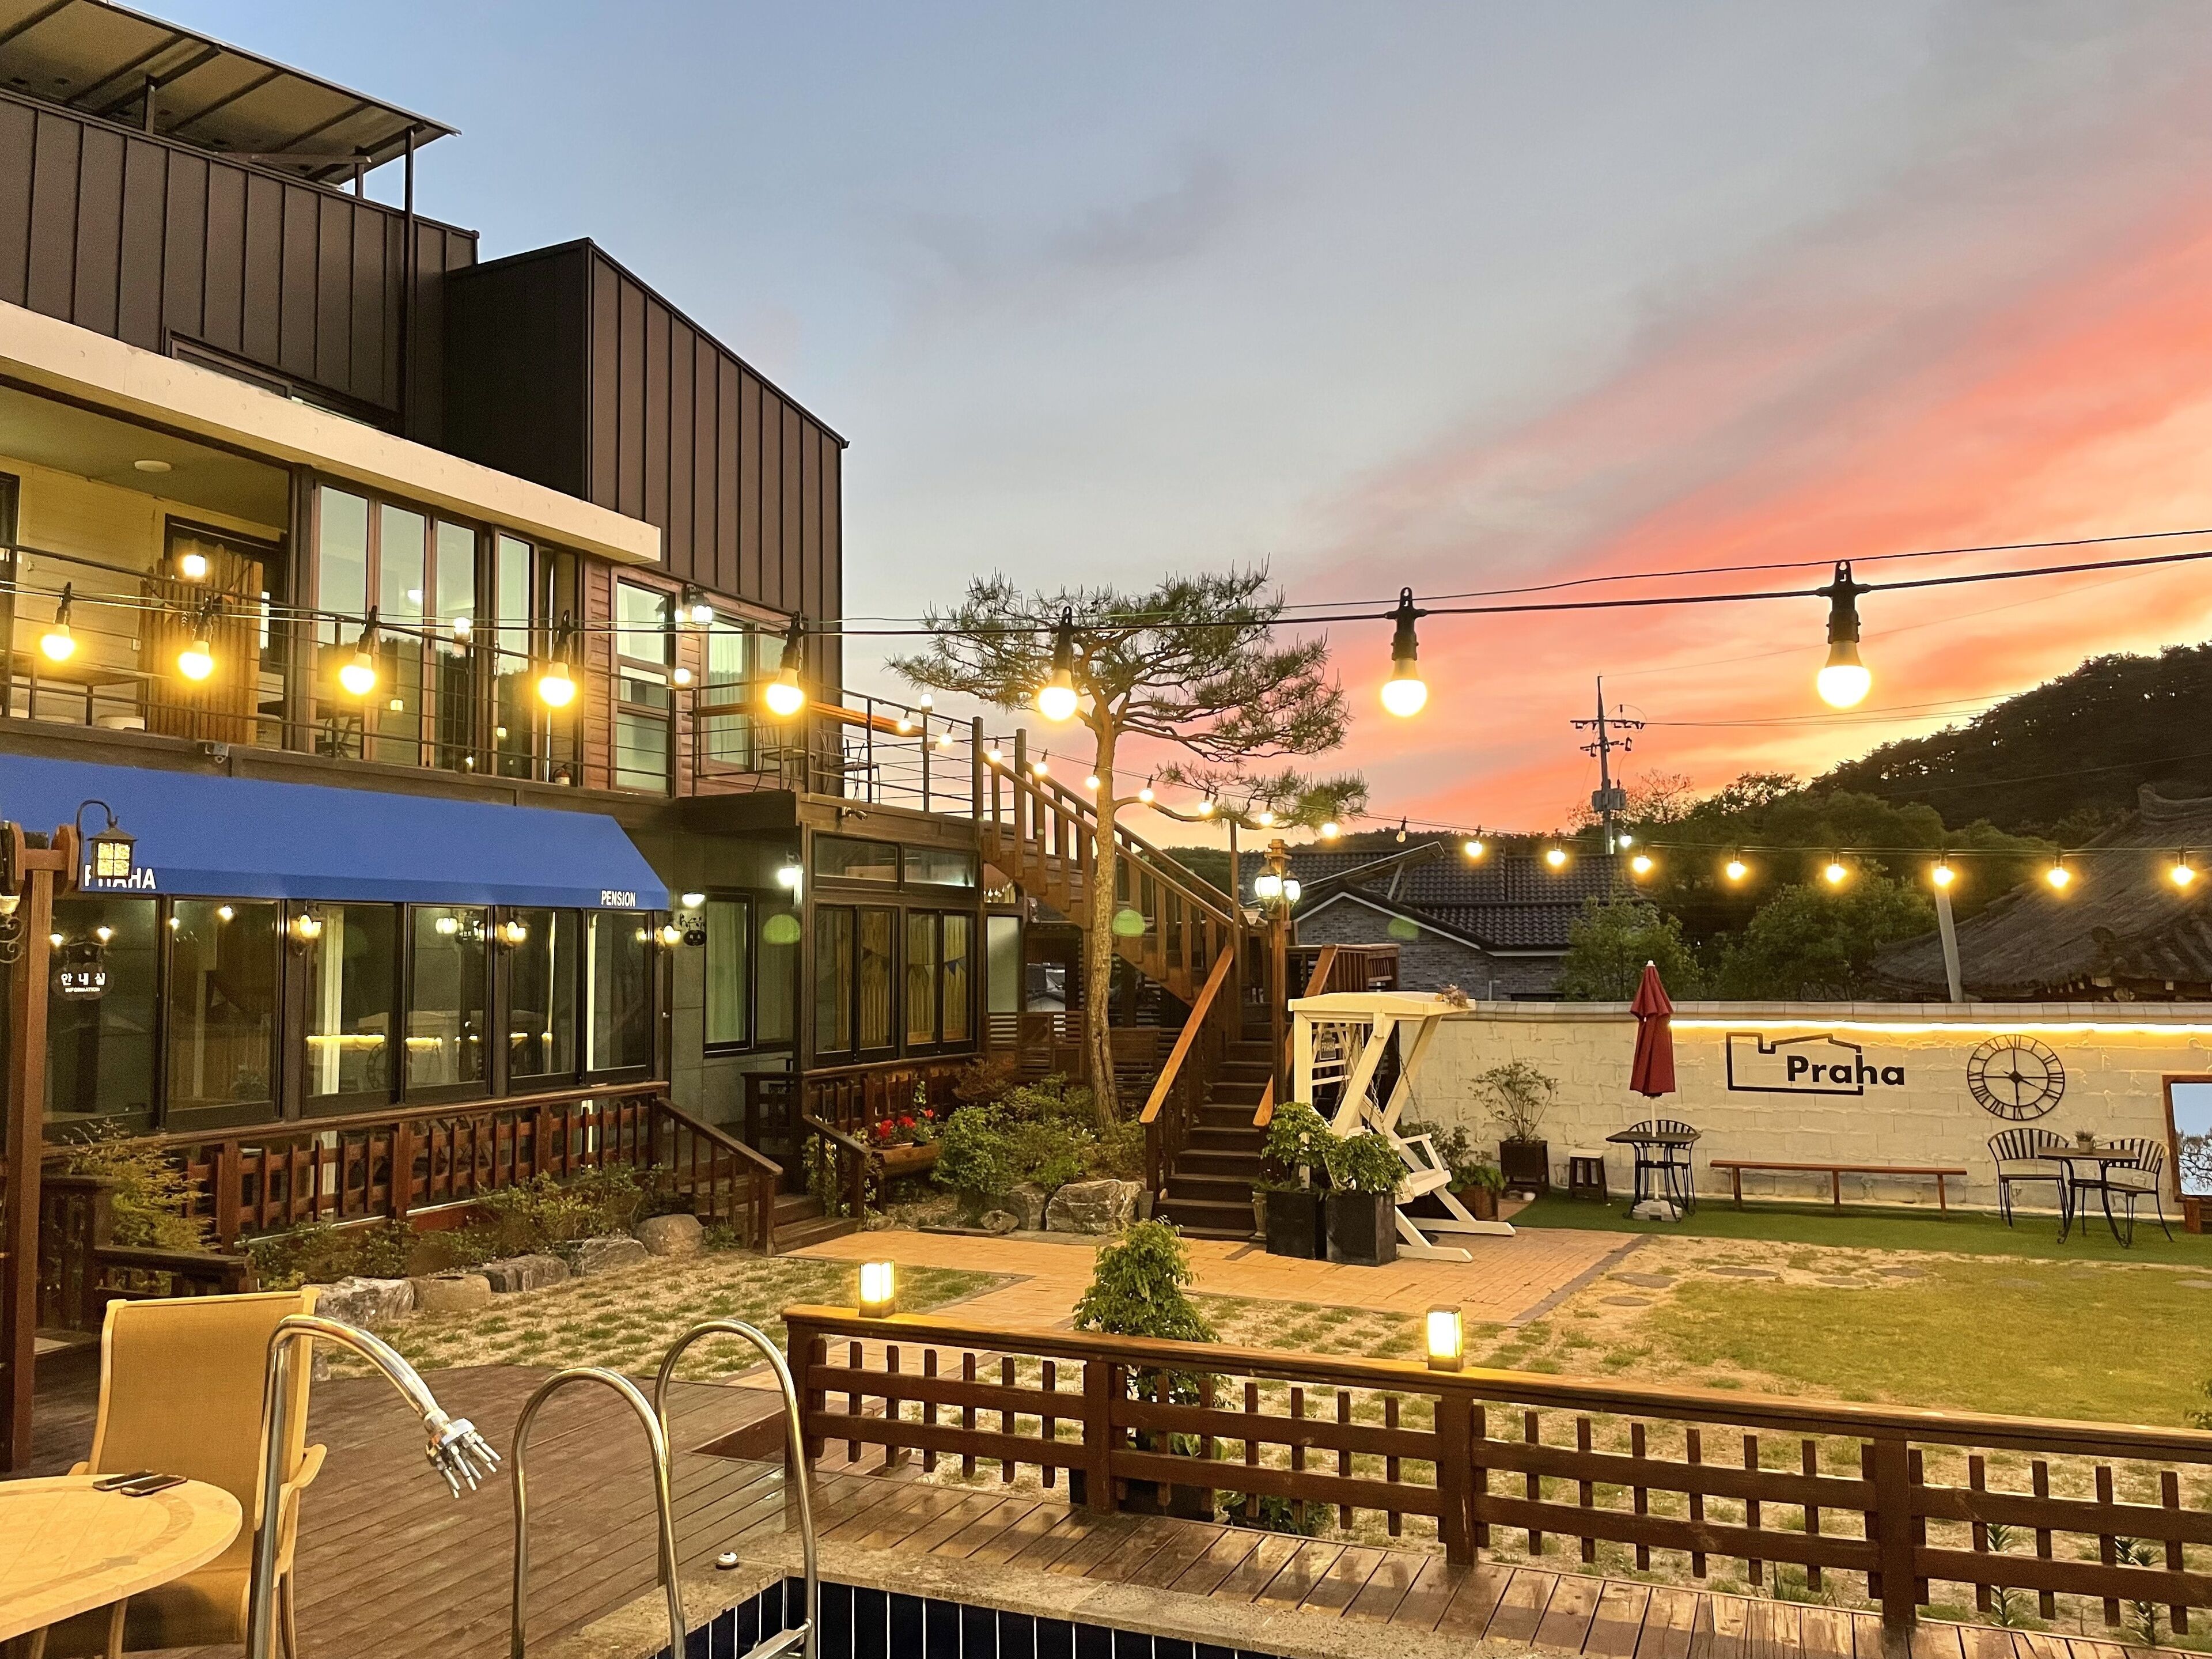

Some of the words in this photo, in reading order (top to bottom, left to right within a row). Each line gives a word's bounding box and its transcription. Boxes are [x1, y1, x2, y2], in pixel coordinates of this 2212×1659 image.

[601, 890, 636, 907] PENSION
[60, 972, 106, 986] 안내실
[1787, 1054, 1905, 1086] Praha
